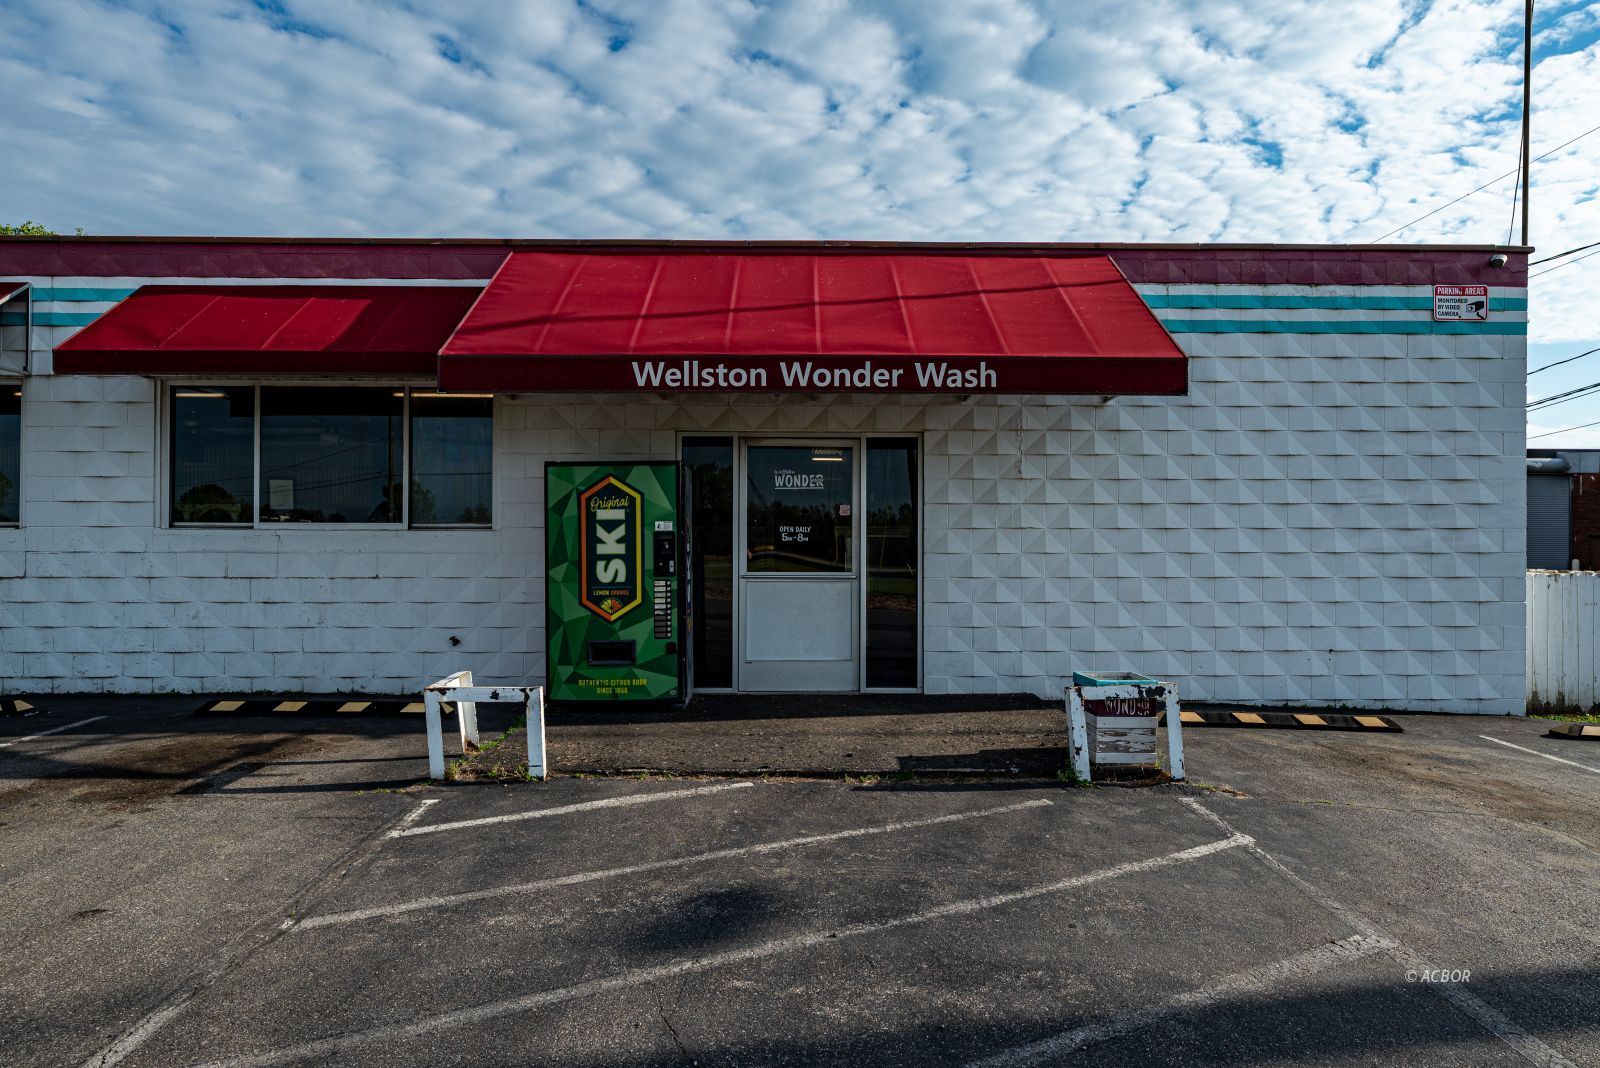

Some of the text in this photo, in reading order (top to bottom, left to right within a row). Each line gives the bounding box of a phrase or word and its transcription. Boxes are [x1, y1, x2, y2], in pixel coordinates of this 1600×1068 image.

[1437, 287, 1485, 295] PARKING AREAS
[631, 360, 998, 388] Wellston Wonder Wash
[774, 474, 824, 487] WONDER
[590, 495, 630, 512] Original
[779, 525, 812, 533] OPEN DAILY
[595, 508, 627, 584] SKI
